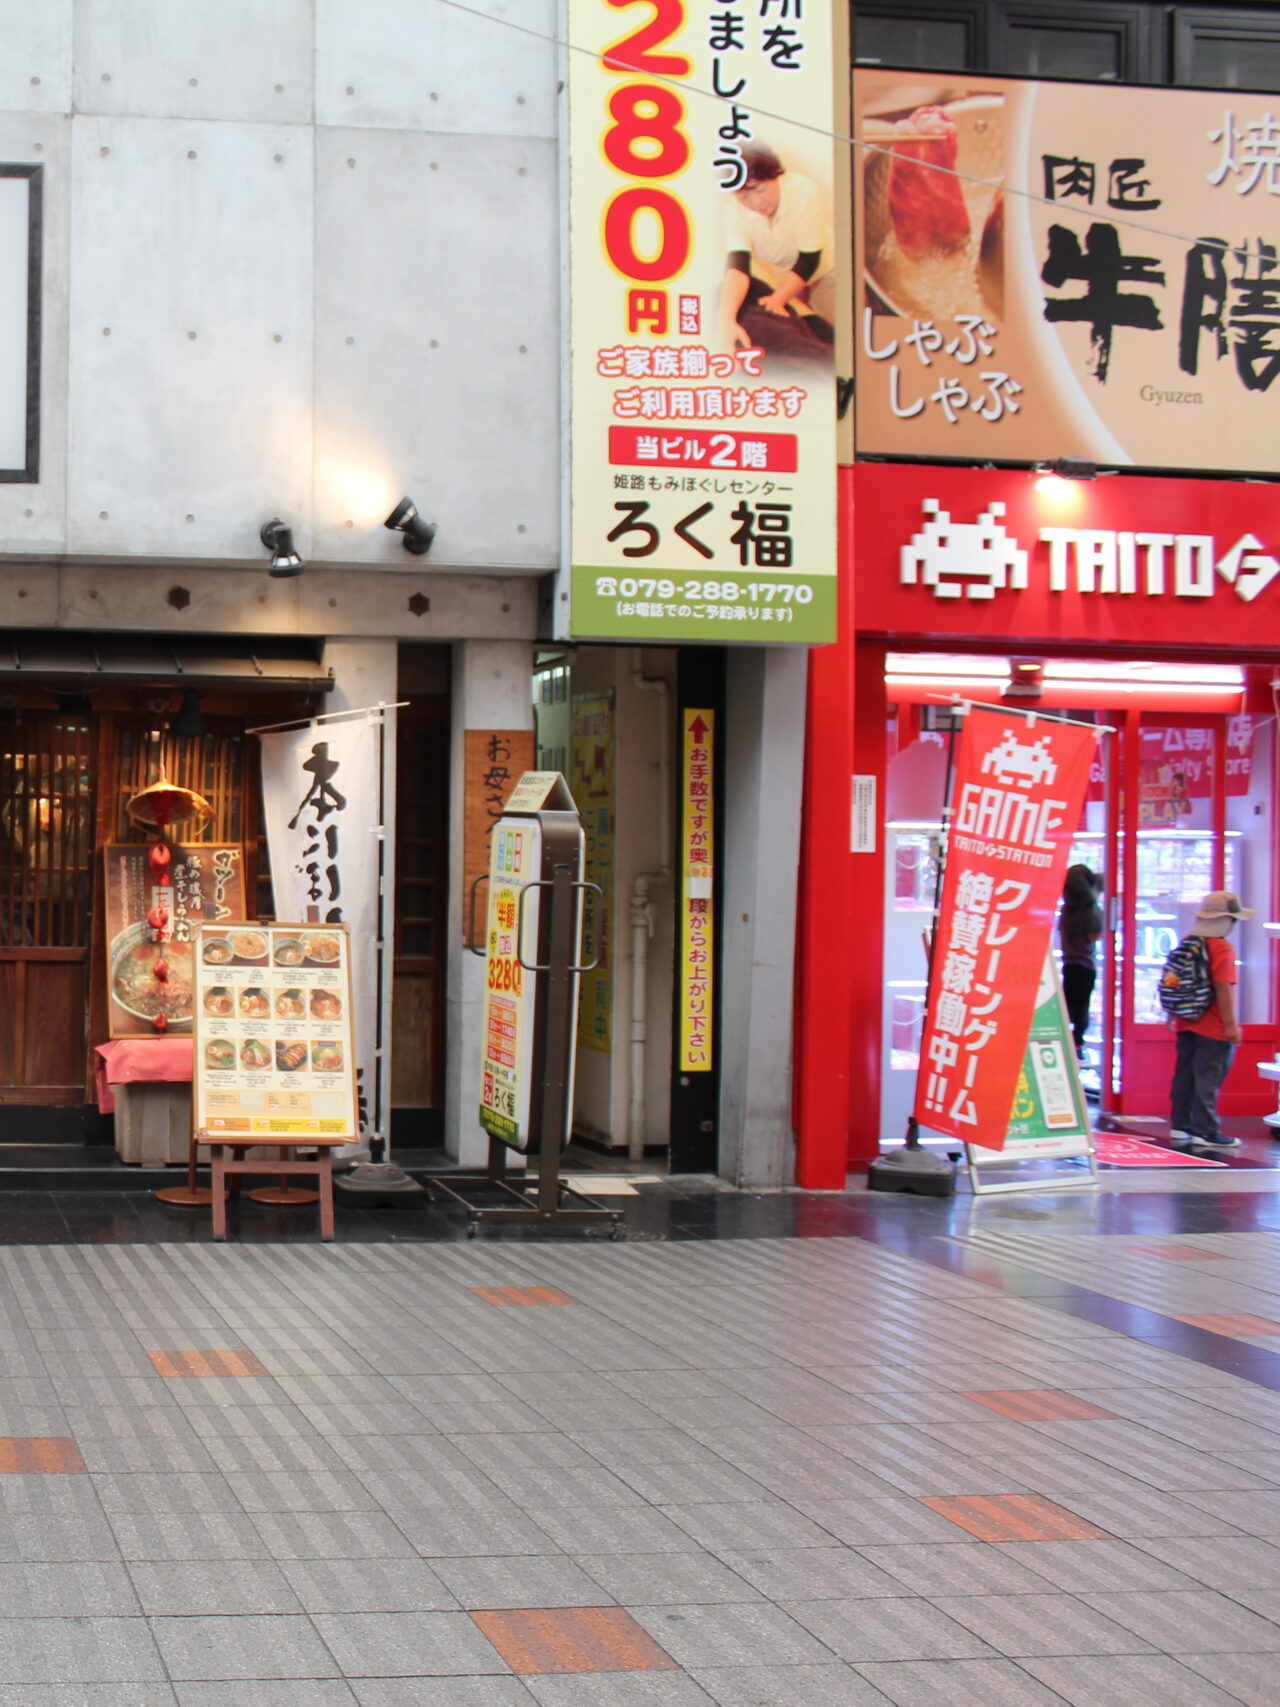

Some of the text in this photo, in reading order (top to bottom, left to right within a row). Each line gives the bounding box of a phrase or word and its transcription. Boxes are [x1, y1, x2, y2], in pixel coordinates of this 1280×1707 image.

[710, 0, 750, 188] ましょう
[1043, 154, 1161, 210] 肉匠
[597, 346, 765, 378] ご家族揃って
[864, 306, 997, 365] しゃぶ
[613, 386, 806, 419] ご利用頂けます
[890, 365, 1023, 423] しゃぶ
[1140, 386, 1203, 406] Gyuzen
[636, 434, 768, 468] 当ビル2階
[614, 474, 794, 495] 姫路もみほぐしセンター
[606, 500, 793, 567] ろく福
[1039, 527, 1215, 597] TAITO
[957, 783, 1068, 850] GAME
[954, 836, 1053, 868] TAITO STATION
[948, 878, 1031, 1125] クレーンゲーム
